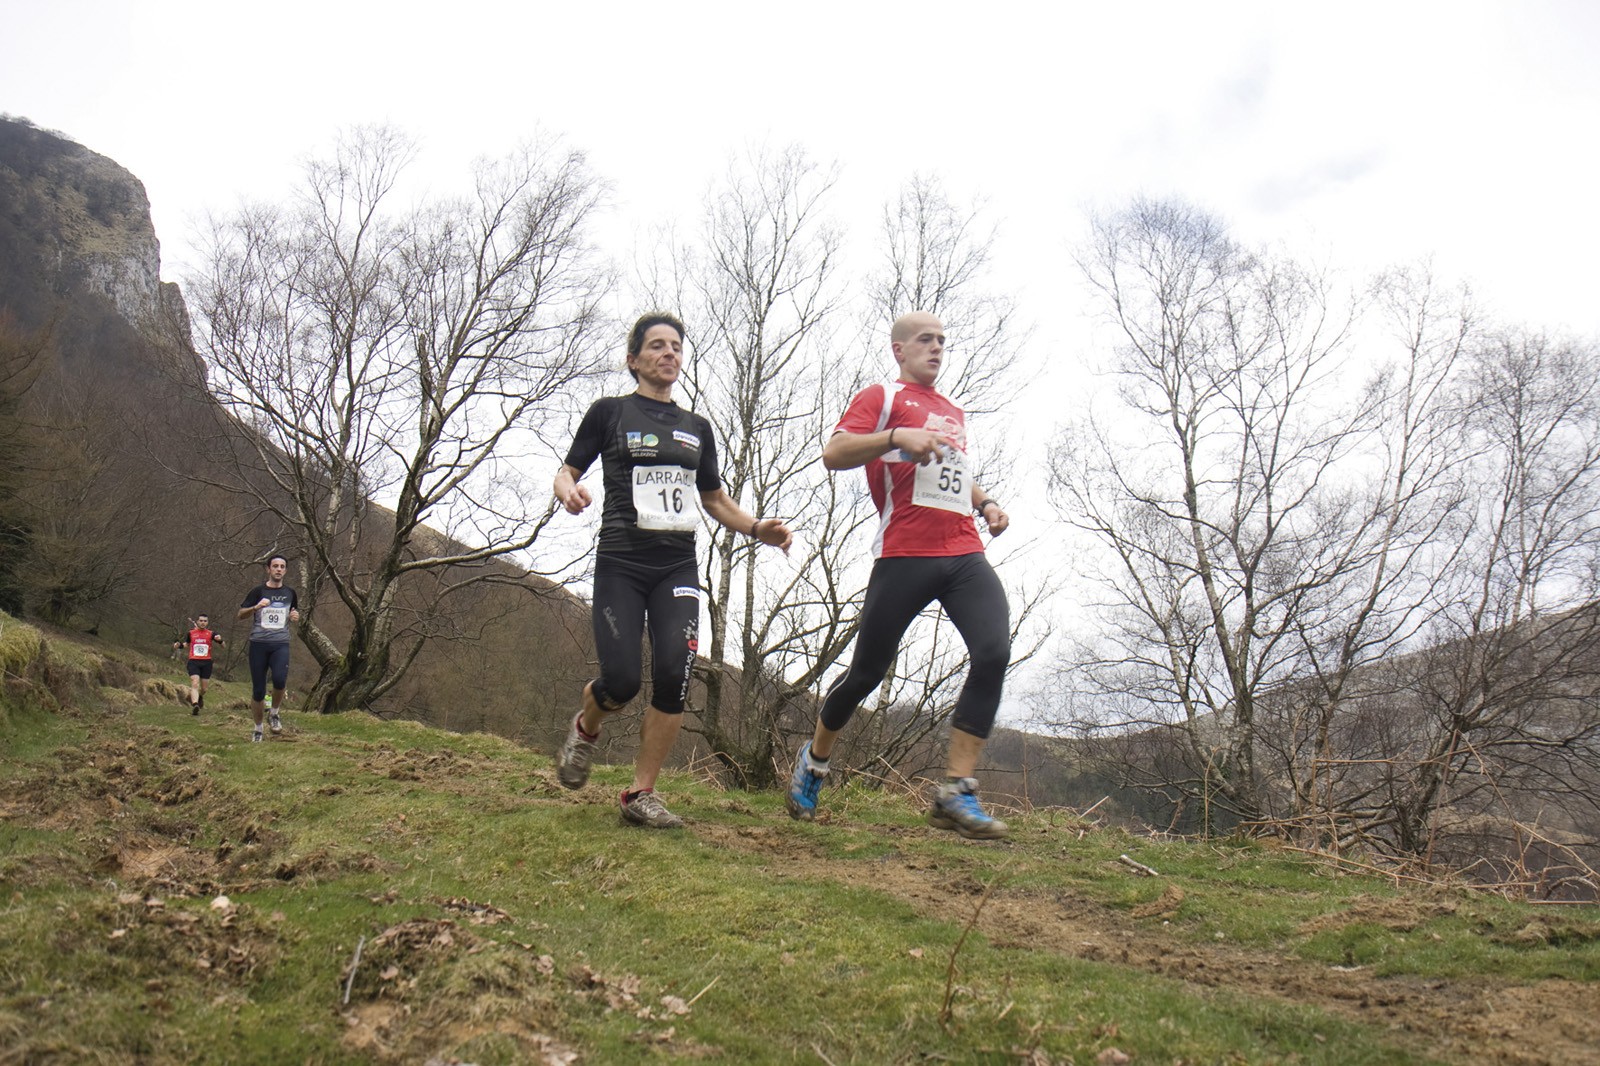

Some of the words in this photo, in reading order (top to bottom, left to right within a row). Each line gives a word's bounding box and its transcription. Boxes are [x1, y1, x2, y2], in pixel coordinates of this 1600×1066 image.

[938, 467, 962, 494] 55
[658, 488, 683, 514] 16
[268, 614, 279, 624] 99
